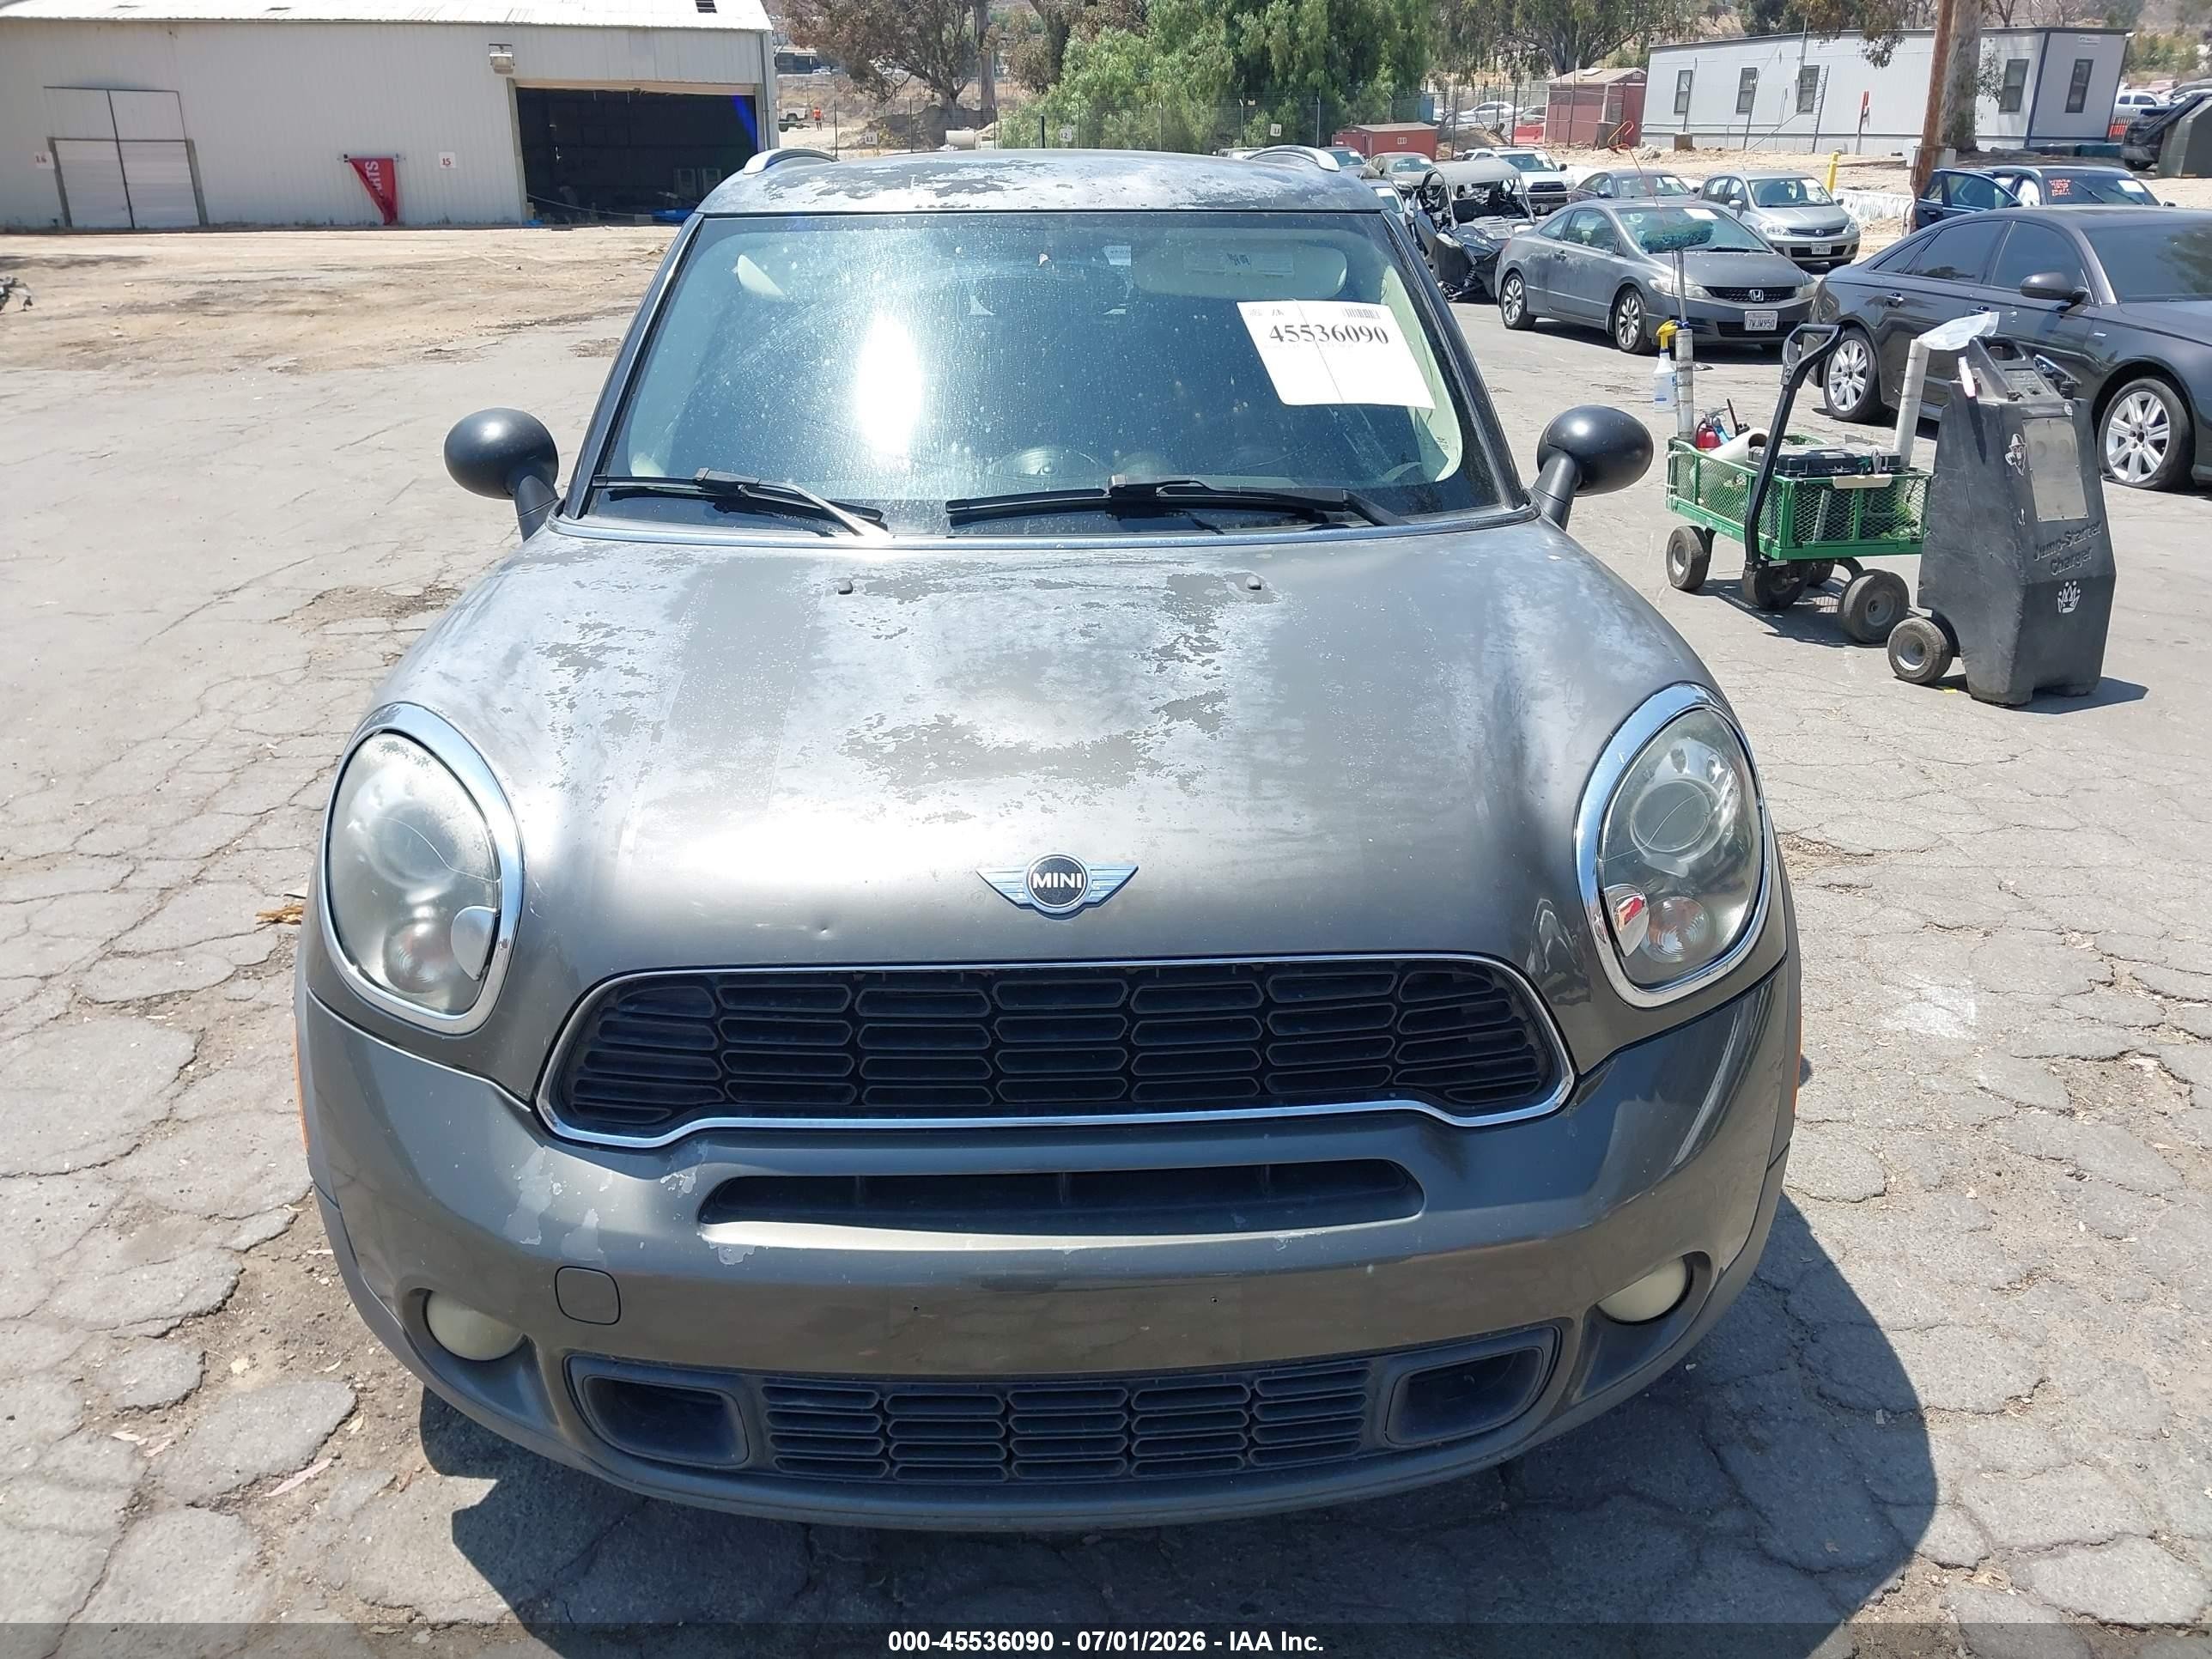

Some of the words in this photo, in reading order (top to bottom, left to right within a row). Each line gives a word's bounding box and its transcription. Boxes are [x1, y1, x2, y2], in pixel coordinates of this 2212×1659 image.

[441, 158, 452, 167] 15
[1269, 324, 1389, 344] 45536090
[2033, 521, 2101, 562] Jump-Starter
[2051, 547, 2092, 575] Charger
[1032, 872, 1083, 889] MINI
